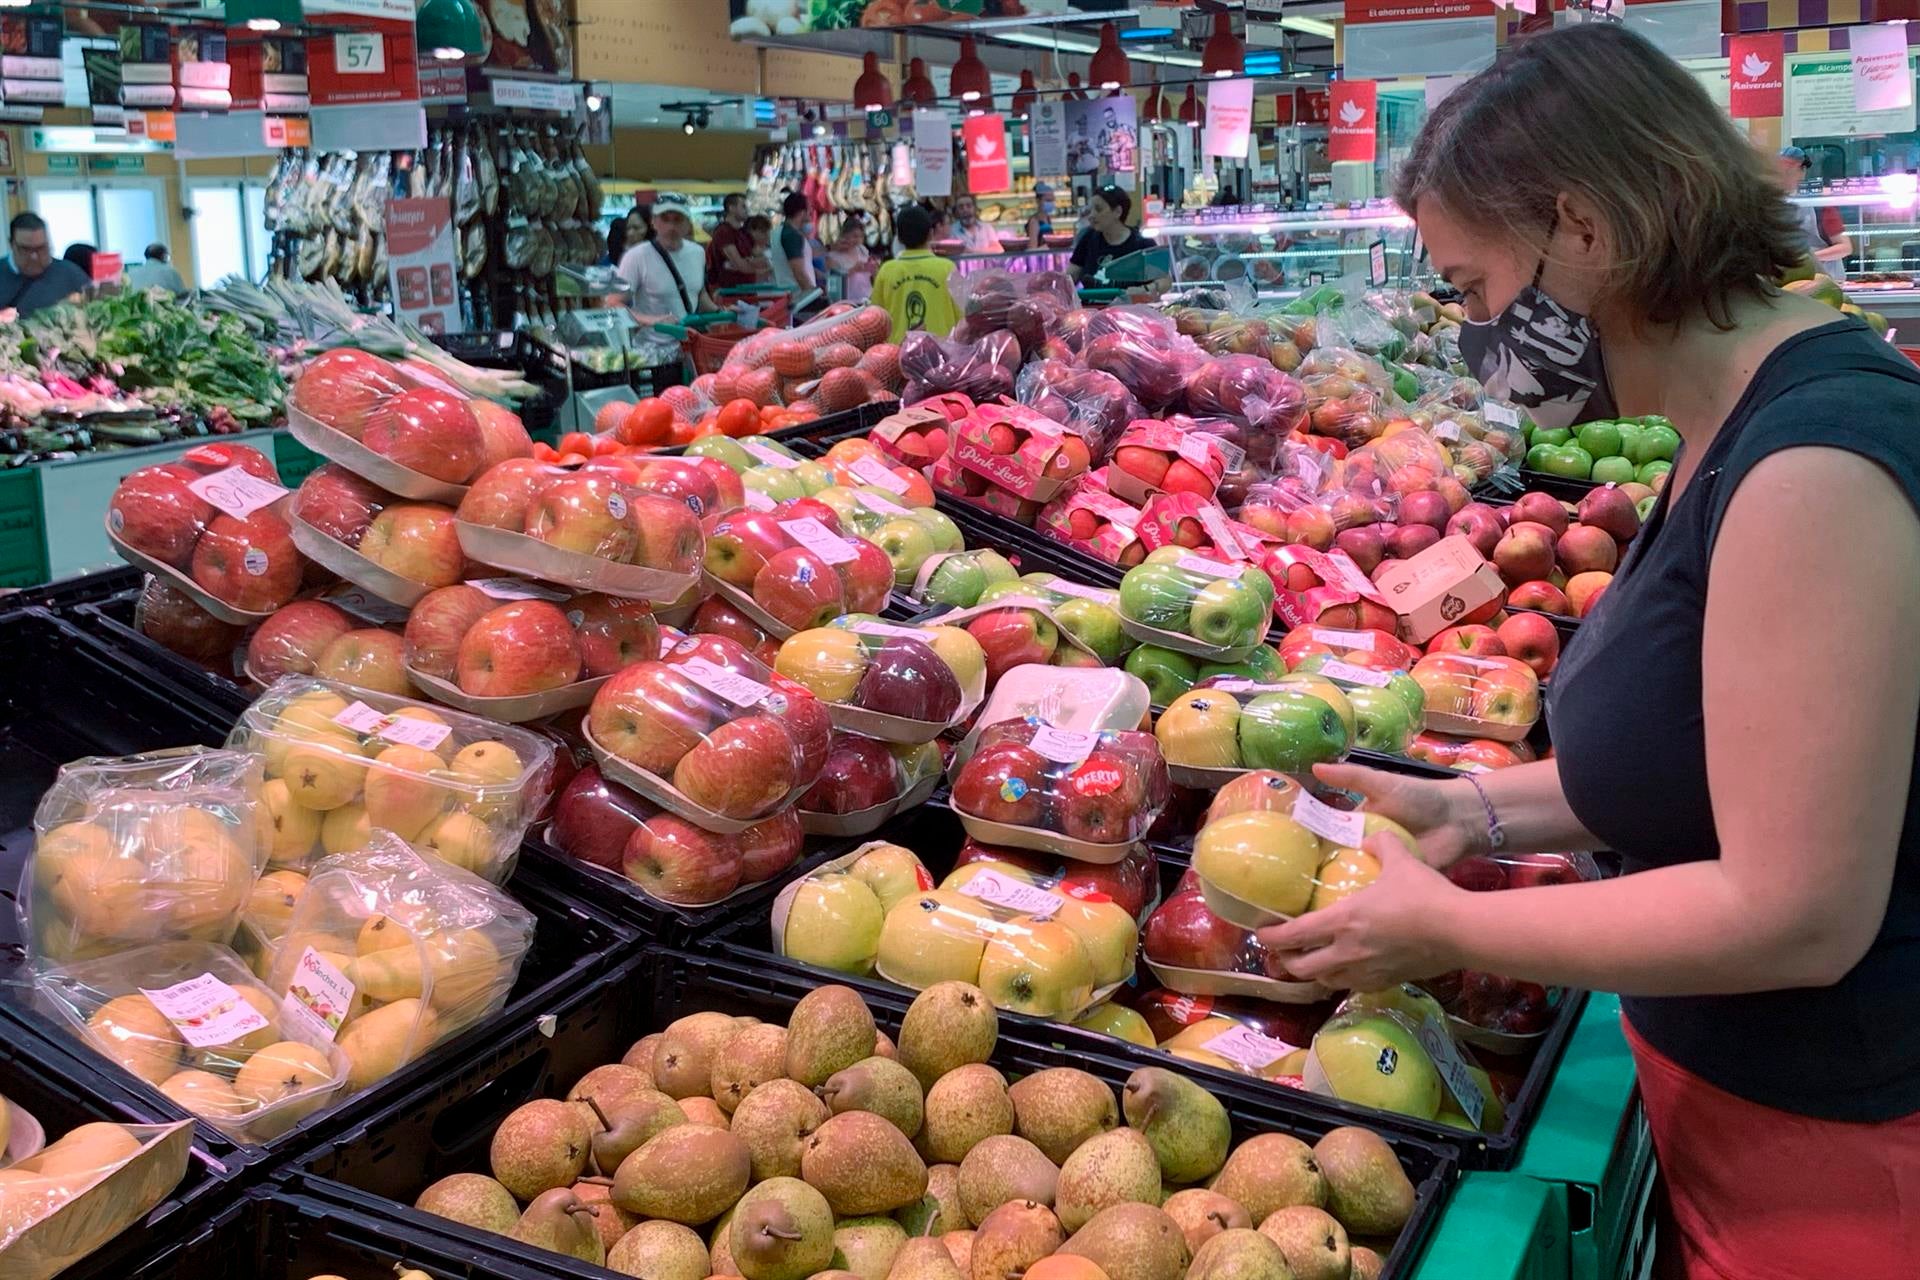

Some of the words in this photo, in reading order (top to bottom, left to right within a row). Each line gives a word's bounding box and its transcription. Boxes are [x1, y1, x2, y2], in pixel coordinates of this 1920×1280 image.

[1368, 9, 1378, 17] El
[1378, 8, 1406, 16] ahorro
[1406, 6, 1424, 15] está
[1425, 6, 1435, 14] en
[1444, 4, 1471, 14] precio
[347, 45, 374, 68] 57
[1732, 80, 1782, 90] Aniversario
[873, 114, 889, 126] 60
[1331, 126, 1375, 134] Aniversario
[960, 445, 995, 470] Pink
[994, 465, 1028, 489] Lady
[1142, 521, 1162, 547] Pin
[1076, 770, 1120, 790] OFERTA
